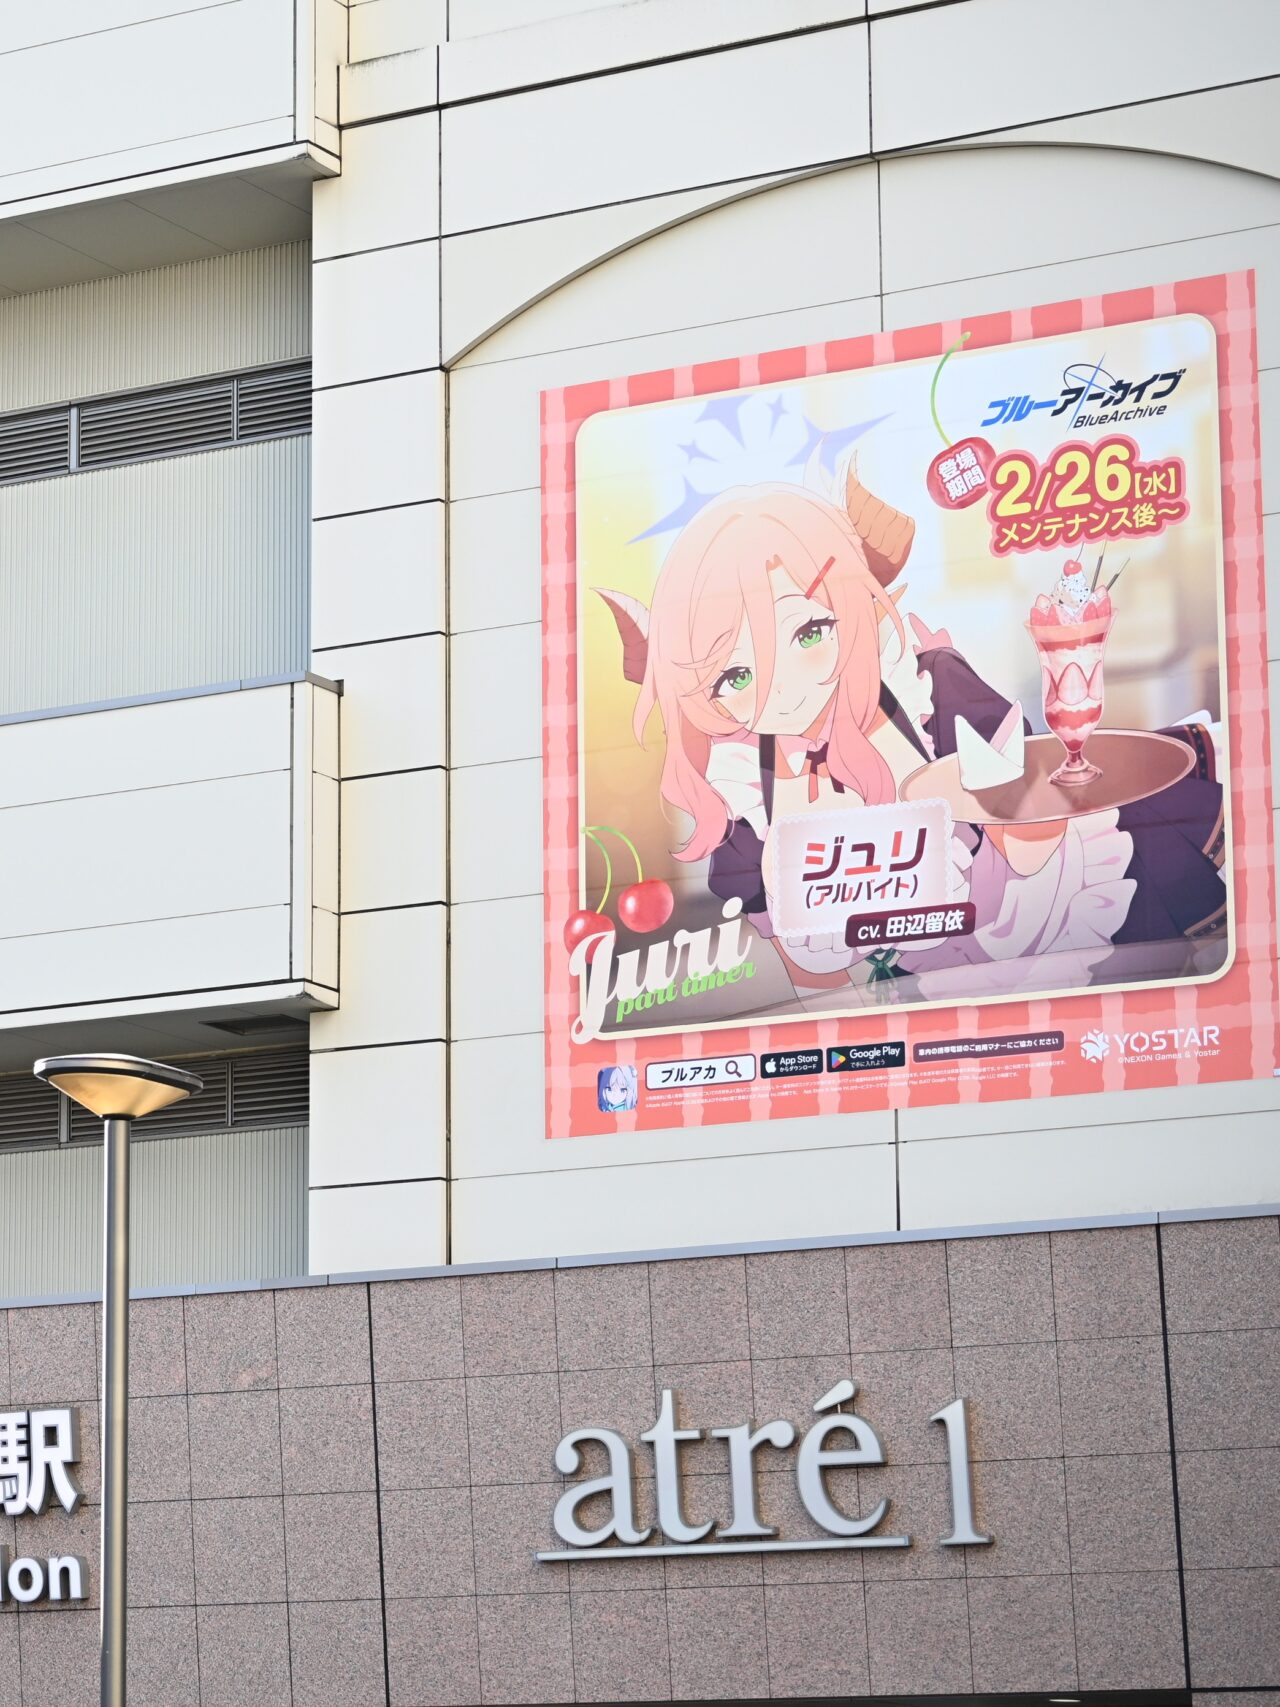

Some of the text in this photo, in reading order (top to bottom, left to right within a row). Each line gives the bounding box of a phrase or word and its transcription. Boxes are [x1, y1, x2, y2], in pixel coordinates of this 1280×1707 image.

[980, 368, 1187, 428] ブルーアーカイブ
[1073, 403, 1168, 429] BlueArchive
[937, 446, 976, 483] 登場
[945, 466, 986, 501] 期間
[802, 828, 927, 882] ジュリ
[806, 874, 918, 909] (アルバイト)
[857, 910, 966, 940] CV. 田辺留依
[568, 896, 753, 1045] Juri
[616, 960, 756, 1023] part timer
[850, 1046, 900, 1060] Google Play
[1114, 1025, 1220, 1054] YOSTAR
[779, 1054, 819, 1067] App Store
[779, 1063, 817, 1073] からダウンロード
[850, 1060, 886, 1069] で手に入れよう
[1155, 1051, 1182, 1062] Games
[1194, 1048, 1221, 1058] Yostar
[660, 1064, 717, 1083] ブルアカ
[552, 1378, 995, 1548] atré 1
